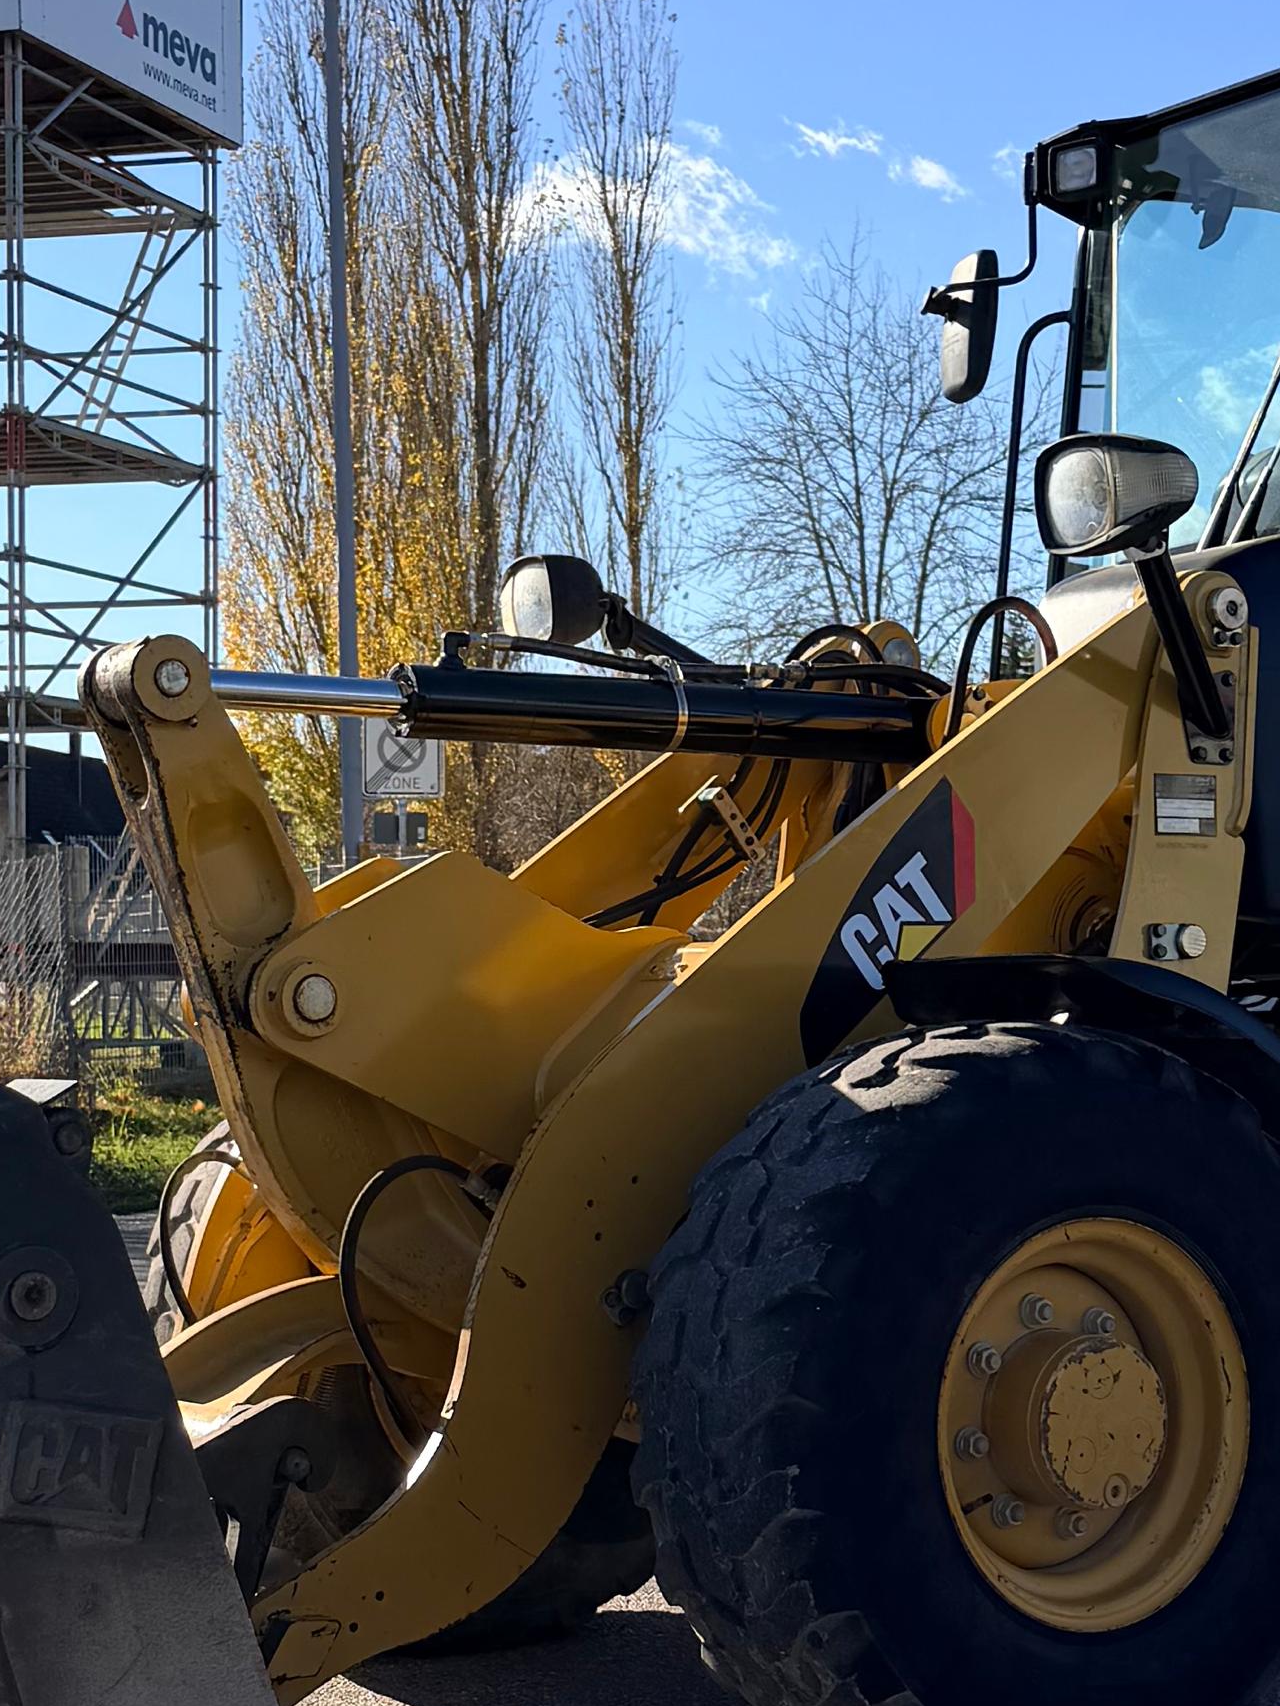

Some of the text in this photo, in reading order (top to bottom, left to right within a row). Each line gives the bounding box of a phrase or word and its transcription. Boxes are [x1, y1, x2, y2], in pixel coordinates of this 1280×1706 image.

[142, 12, 217, 86] meva
[142, 61, 217, 113] www.meva.net
[384, 776, 422, 791] ZONE
[840, 851, 953, 991] CAT
[10, 1420, 153, 1516] CAT
